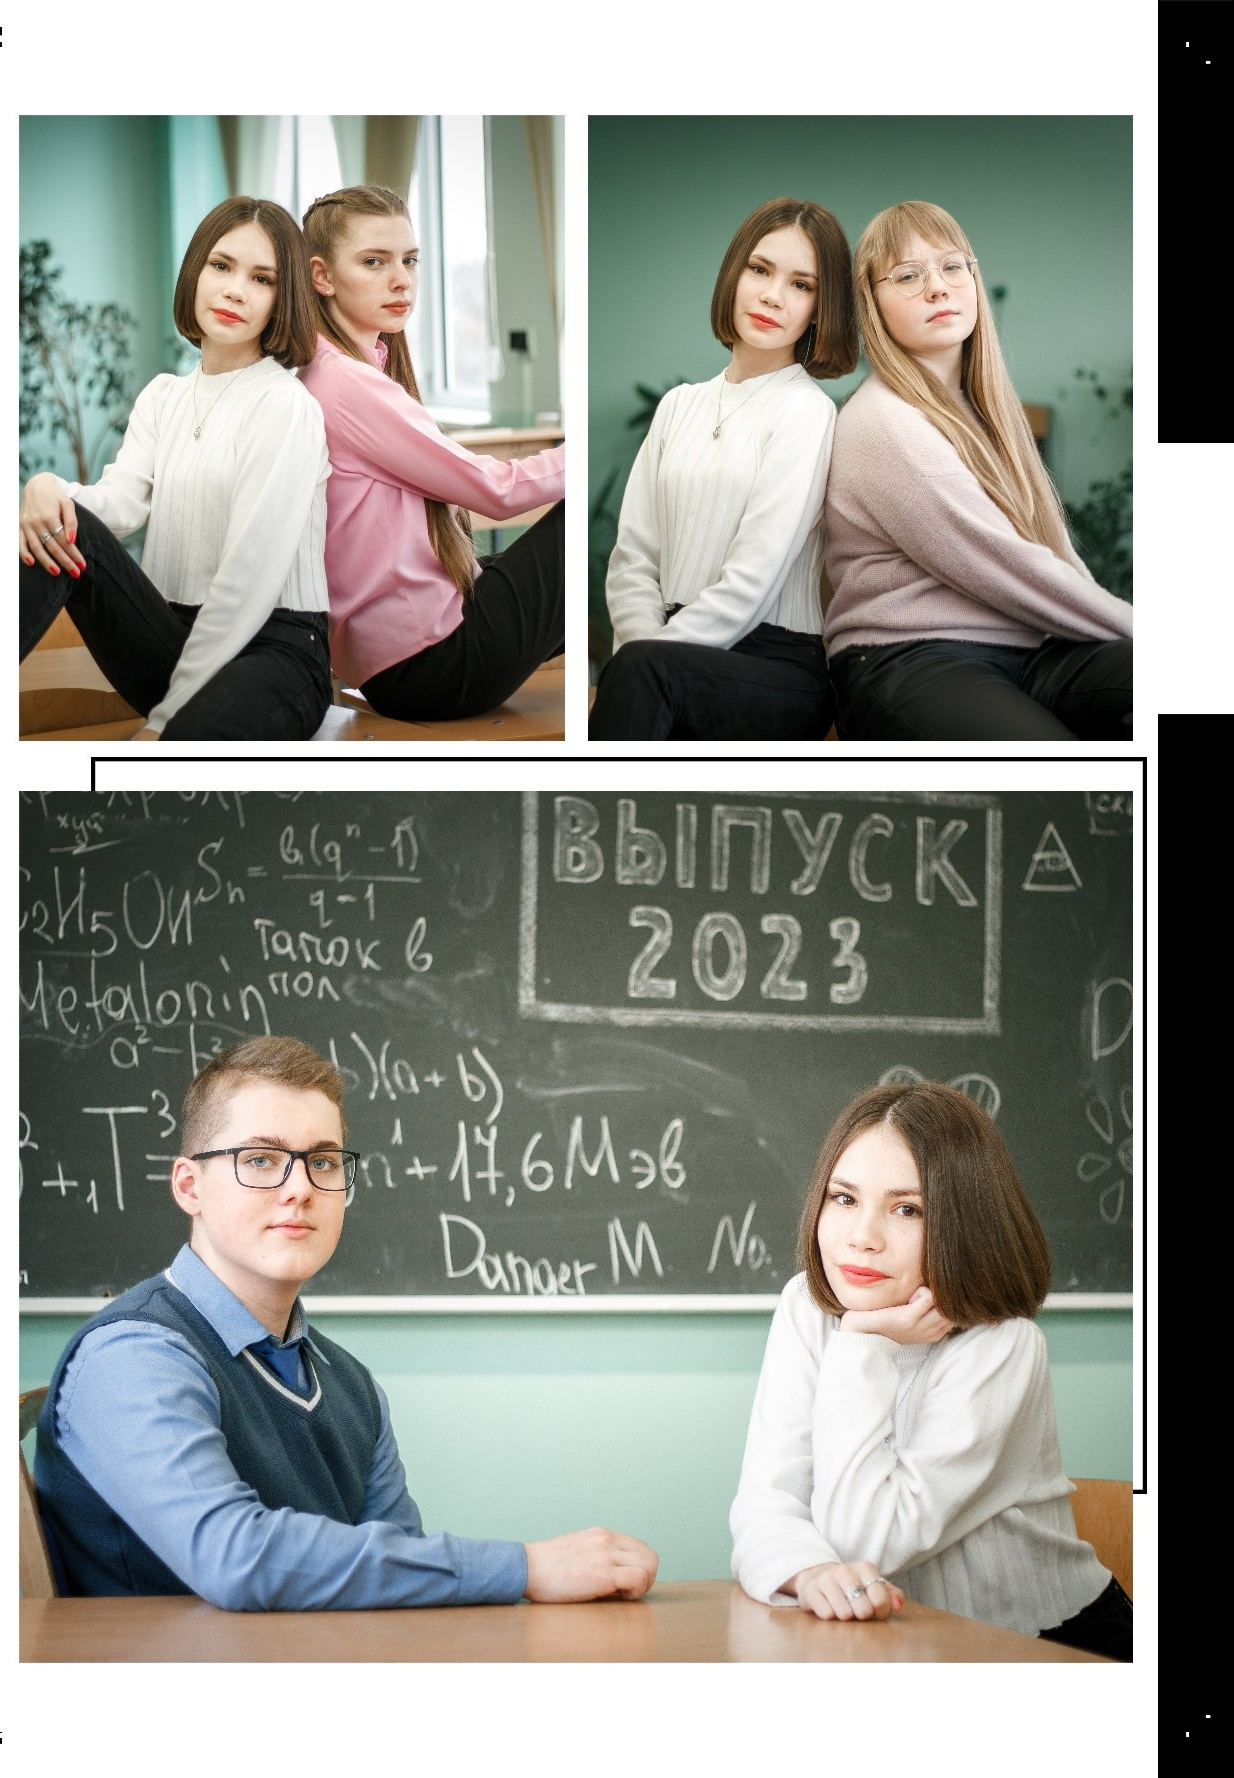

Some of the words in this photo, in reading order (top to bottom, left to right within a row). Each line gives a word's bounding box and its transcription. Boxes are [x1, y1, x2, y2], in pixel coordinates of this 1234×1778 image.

[553, 796, 978, 907] ВЫПУСК
[253, 918, 382, 971] Тапок
[627, 905, 868, 1004] 2023
[268, 971, 339, 1001] пол
